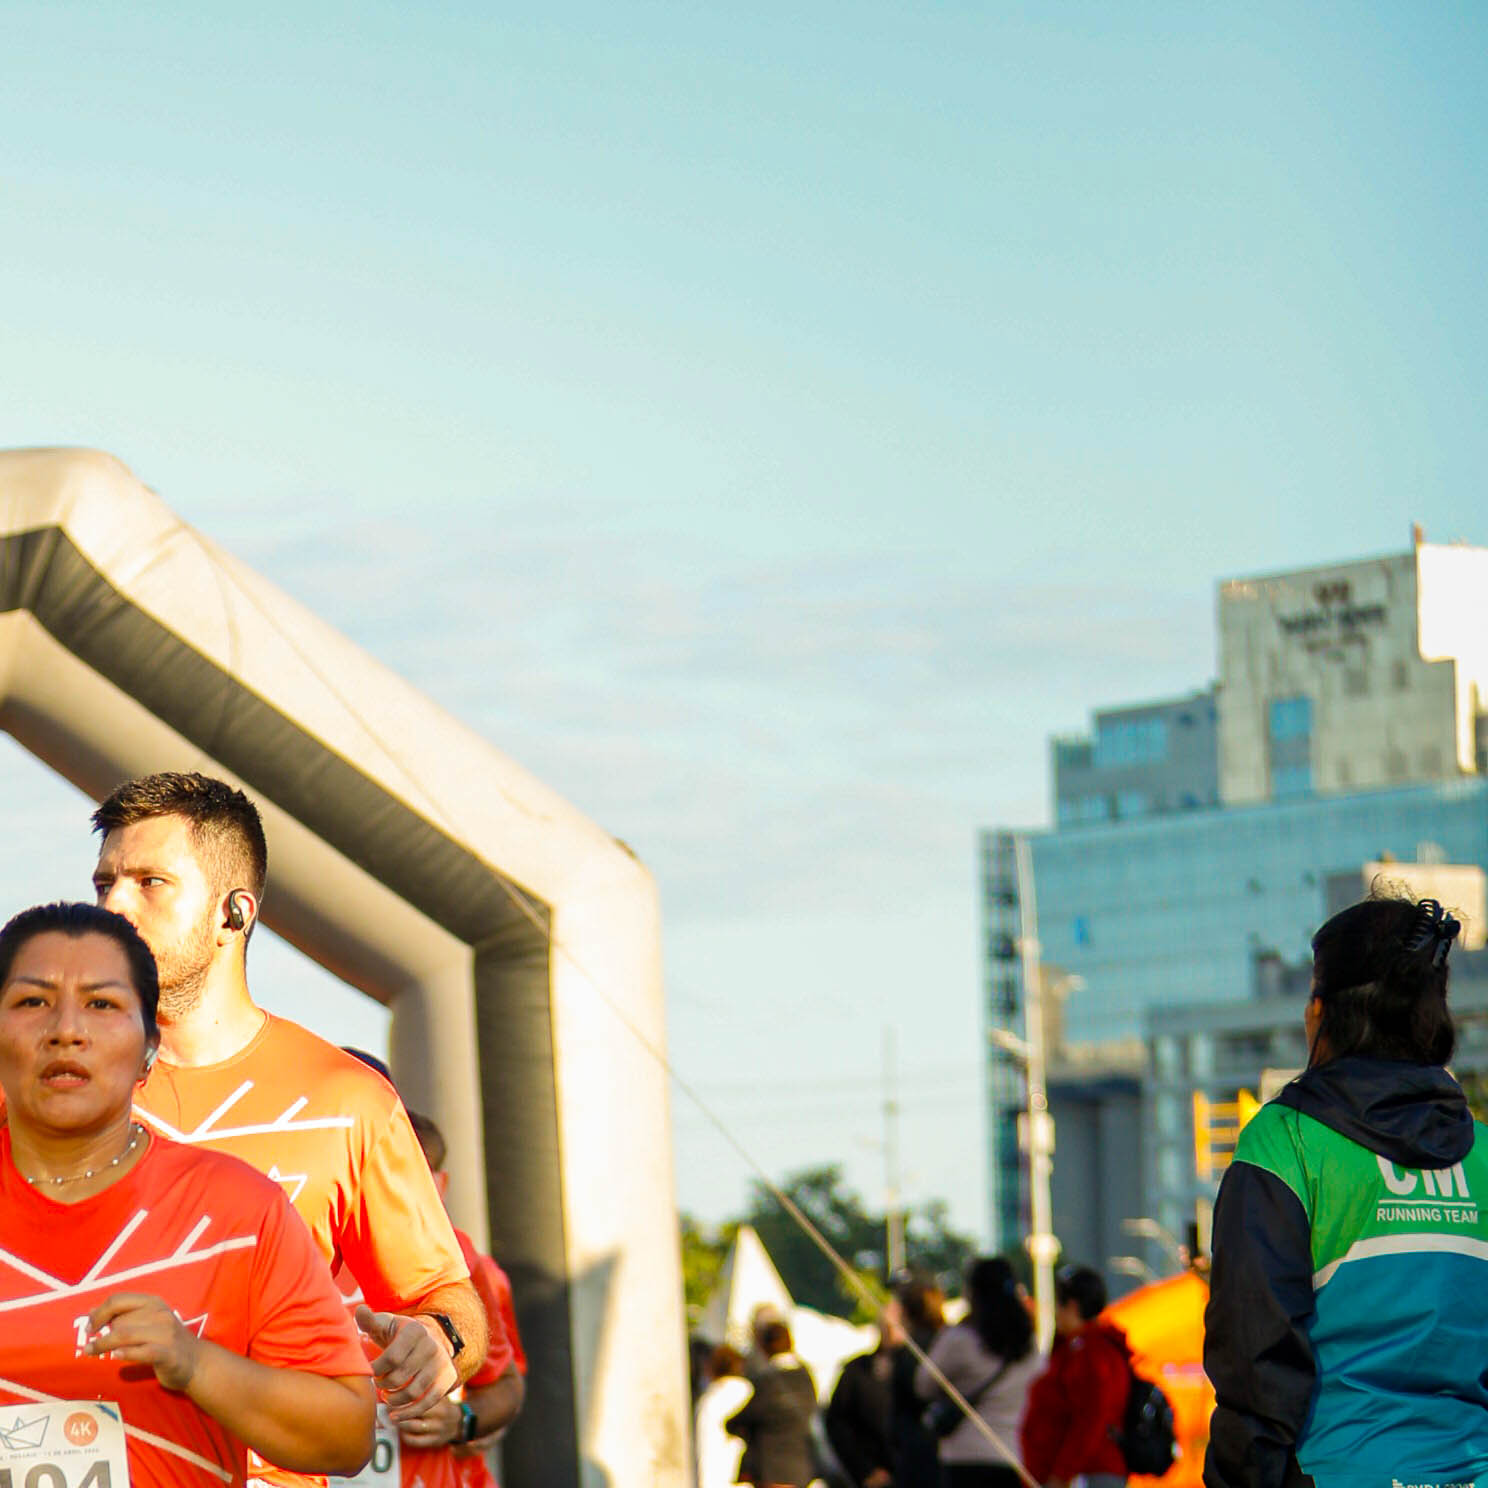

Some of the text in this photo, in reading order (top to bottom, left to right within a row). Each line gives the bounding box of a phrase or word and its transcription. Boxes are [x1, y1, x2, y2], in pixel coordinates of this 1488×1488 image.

[1376, 1207, 1479, 1225] RUNNING TEAM
[69, 1421, 93, 1439] 4K
